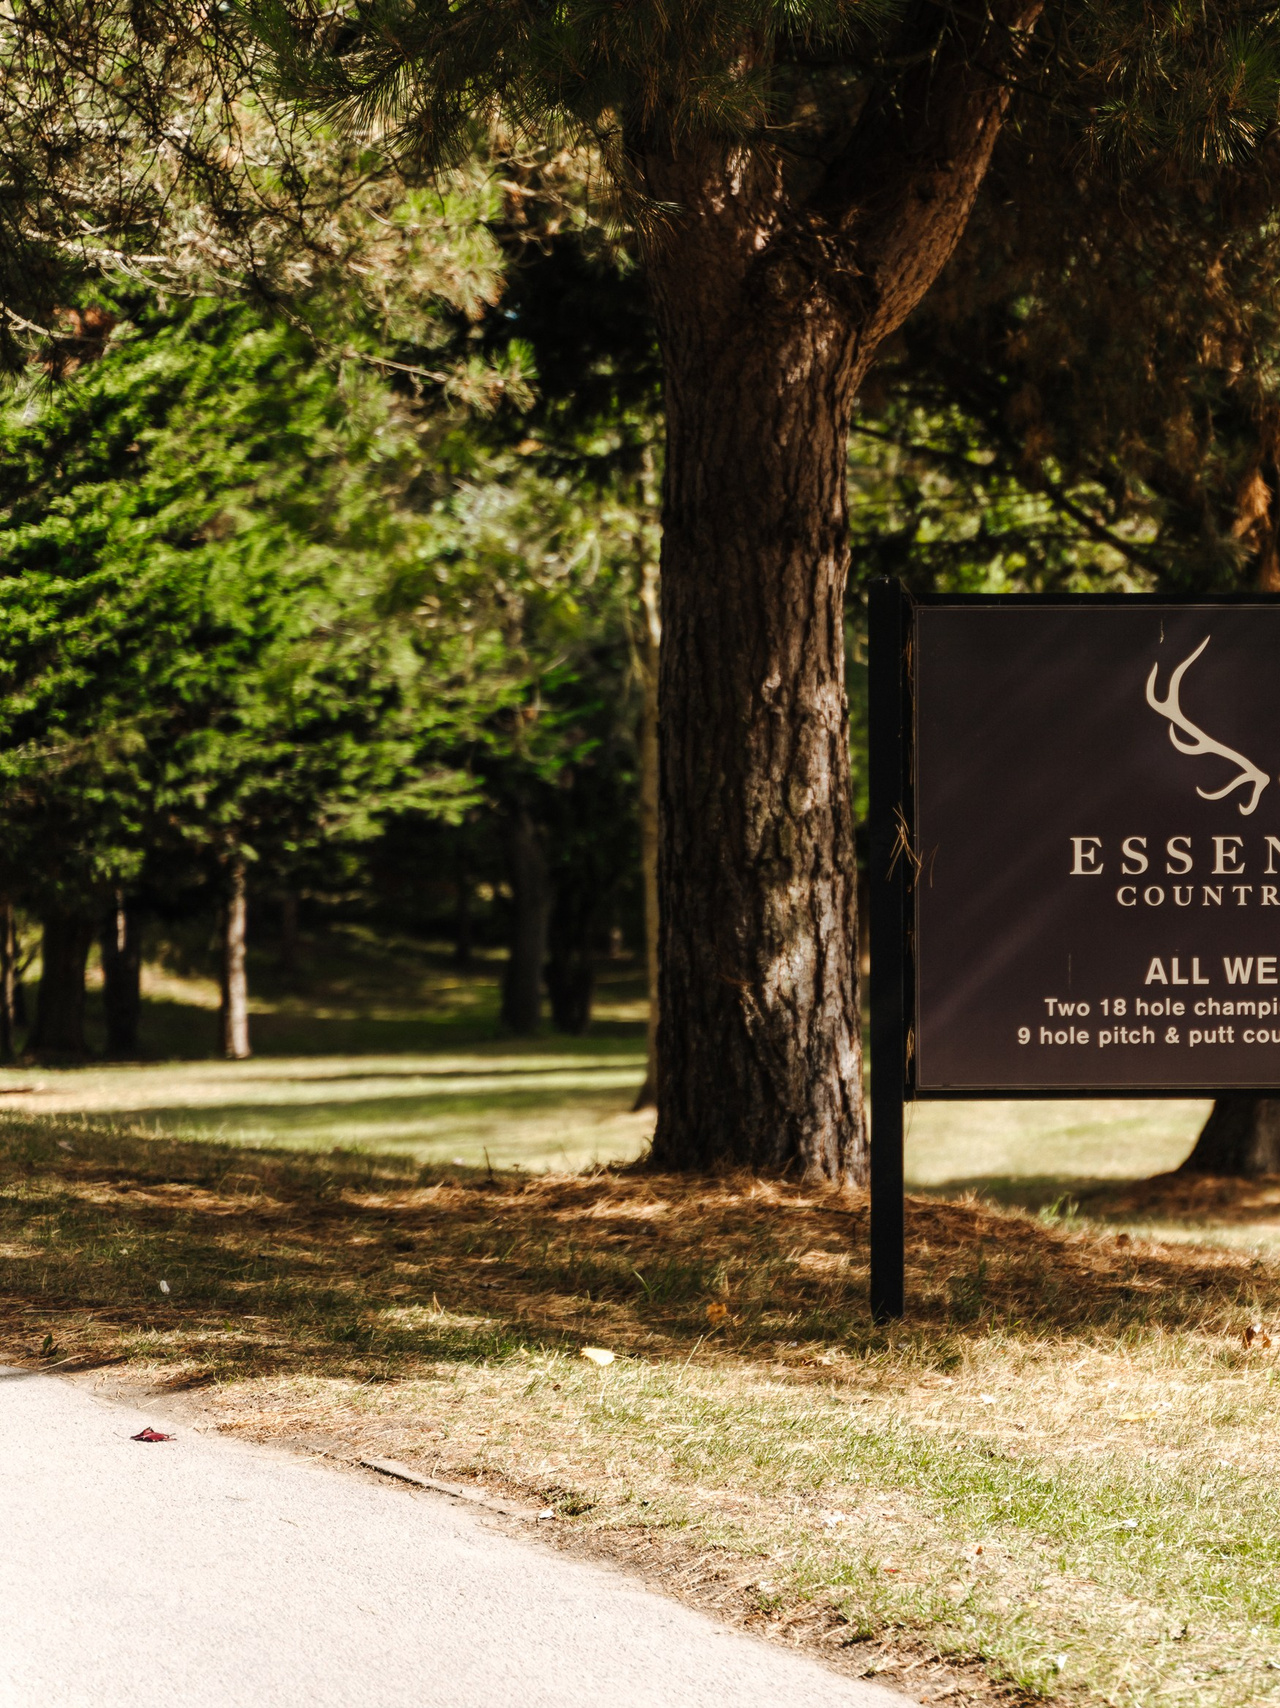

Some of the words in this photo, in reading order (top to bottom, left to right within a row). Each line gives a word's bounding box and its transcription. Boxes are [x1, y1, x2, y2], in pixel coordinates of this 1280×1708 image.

[1144, 957, 1210, 985] ALL
[1044, 998, 1091, 1017] Two
[1099, 998, 1127, 1017] 18
[1135, 997, 1186, 1017] hole
[1017, 1026, 1031, 1045] 9
[1039, 1026, 1090, 1045] hole
[1098, 1025, 1156, 1048] pitch
[1164, 1026, 1180, 1044] &
[1189, 1025, 1235, 1048] putt
